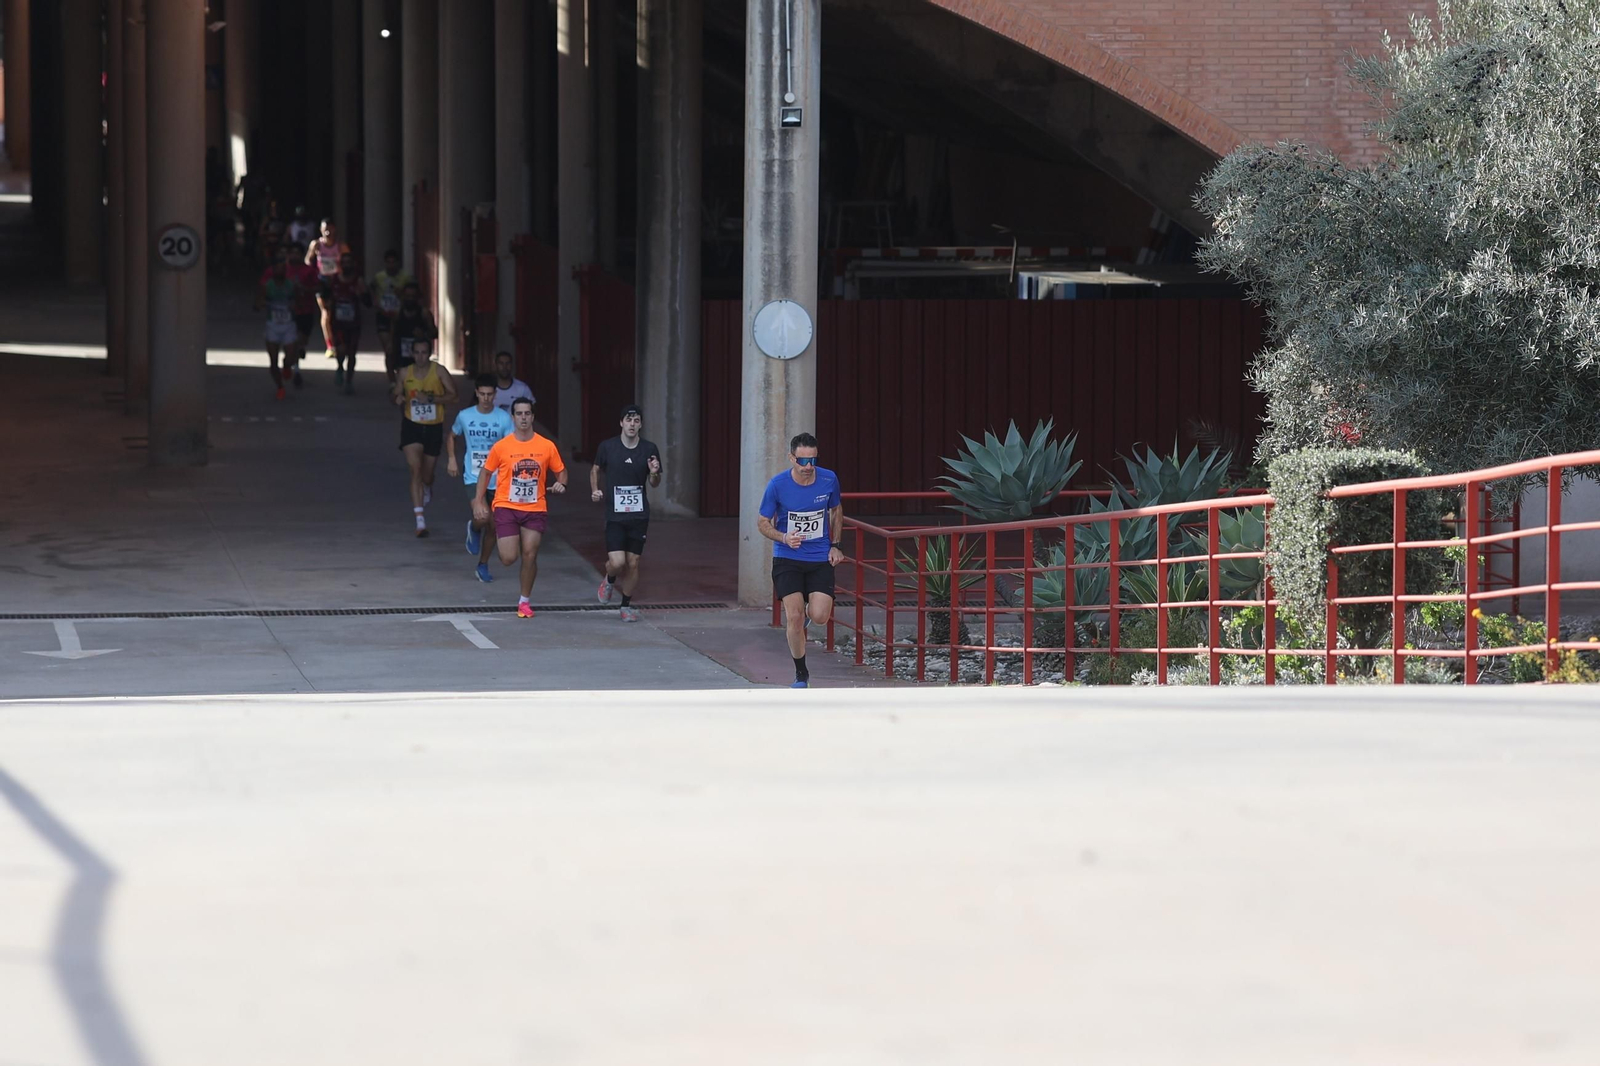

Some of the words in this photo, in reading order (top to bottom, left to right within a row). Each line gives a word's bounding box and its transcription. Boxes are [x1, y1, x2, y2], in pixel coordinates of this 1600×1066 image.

[162, 237, 192, 255] 20
[415, 406, 432, 415] 534
[469, 428, 498, 438] nerja
[515, 487, 534, 496] 218
[620, 495, 639, 505] 255
[794, 520, 819, 532] 520
